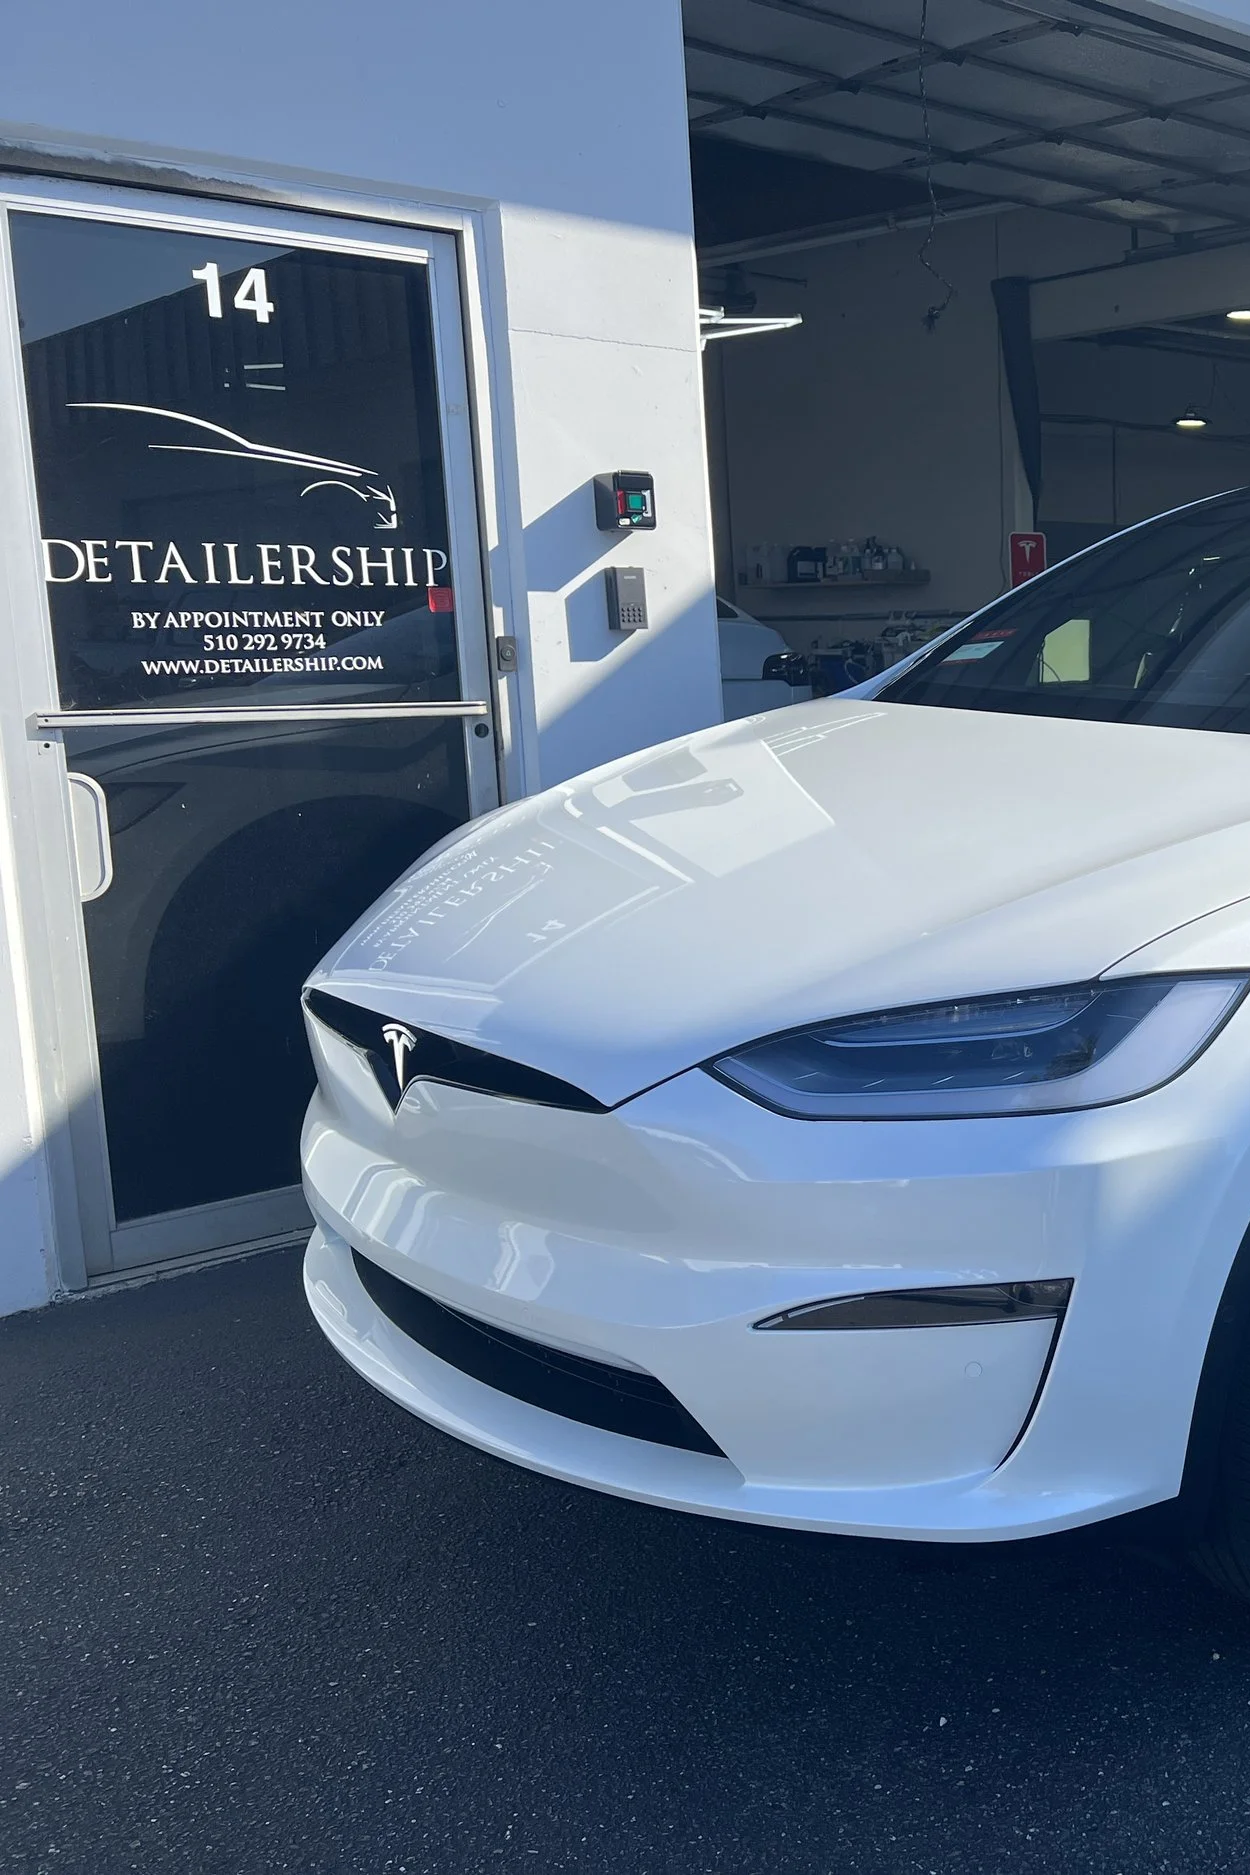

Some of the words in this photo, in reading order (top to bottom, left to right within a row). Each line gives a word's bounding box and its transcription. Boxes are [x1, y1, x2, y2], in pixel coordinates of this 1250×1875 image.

[191, 262, 275, 324] 14
[41, 538, 448, 587] DETAILERSHIP
[131, 611, 161, 629] BY
[164, 611, 325, 629] APPOINTMENT
[331, 611, 385, 628] ONLY
[203, 634, 239, 652] 510
[242, 634, 278, 651] 292
[281, 633, 327, 651] 9734
[140, 655, 384, 676] WWW.DETAILERSHIP.COM
